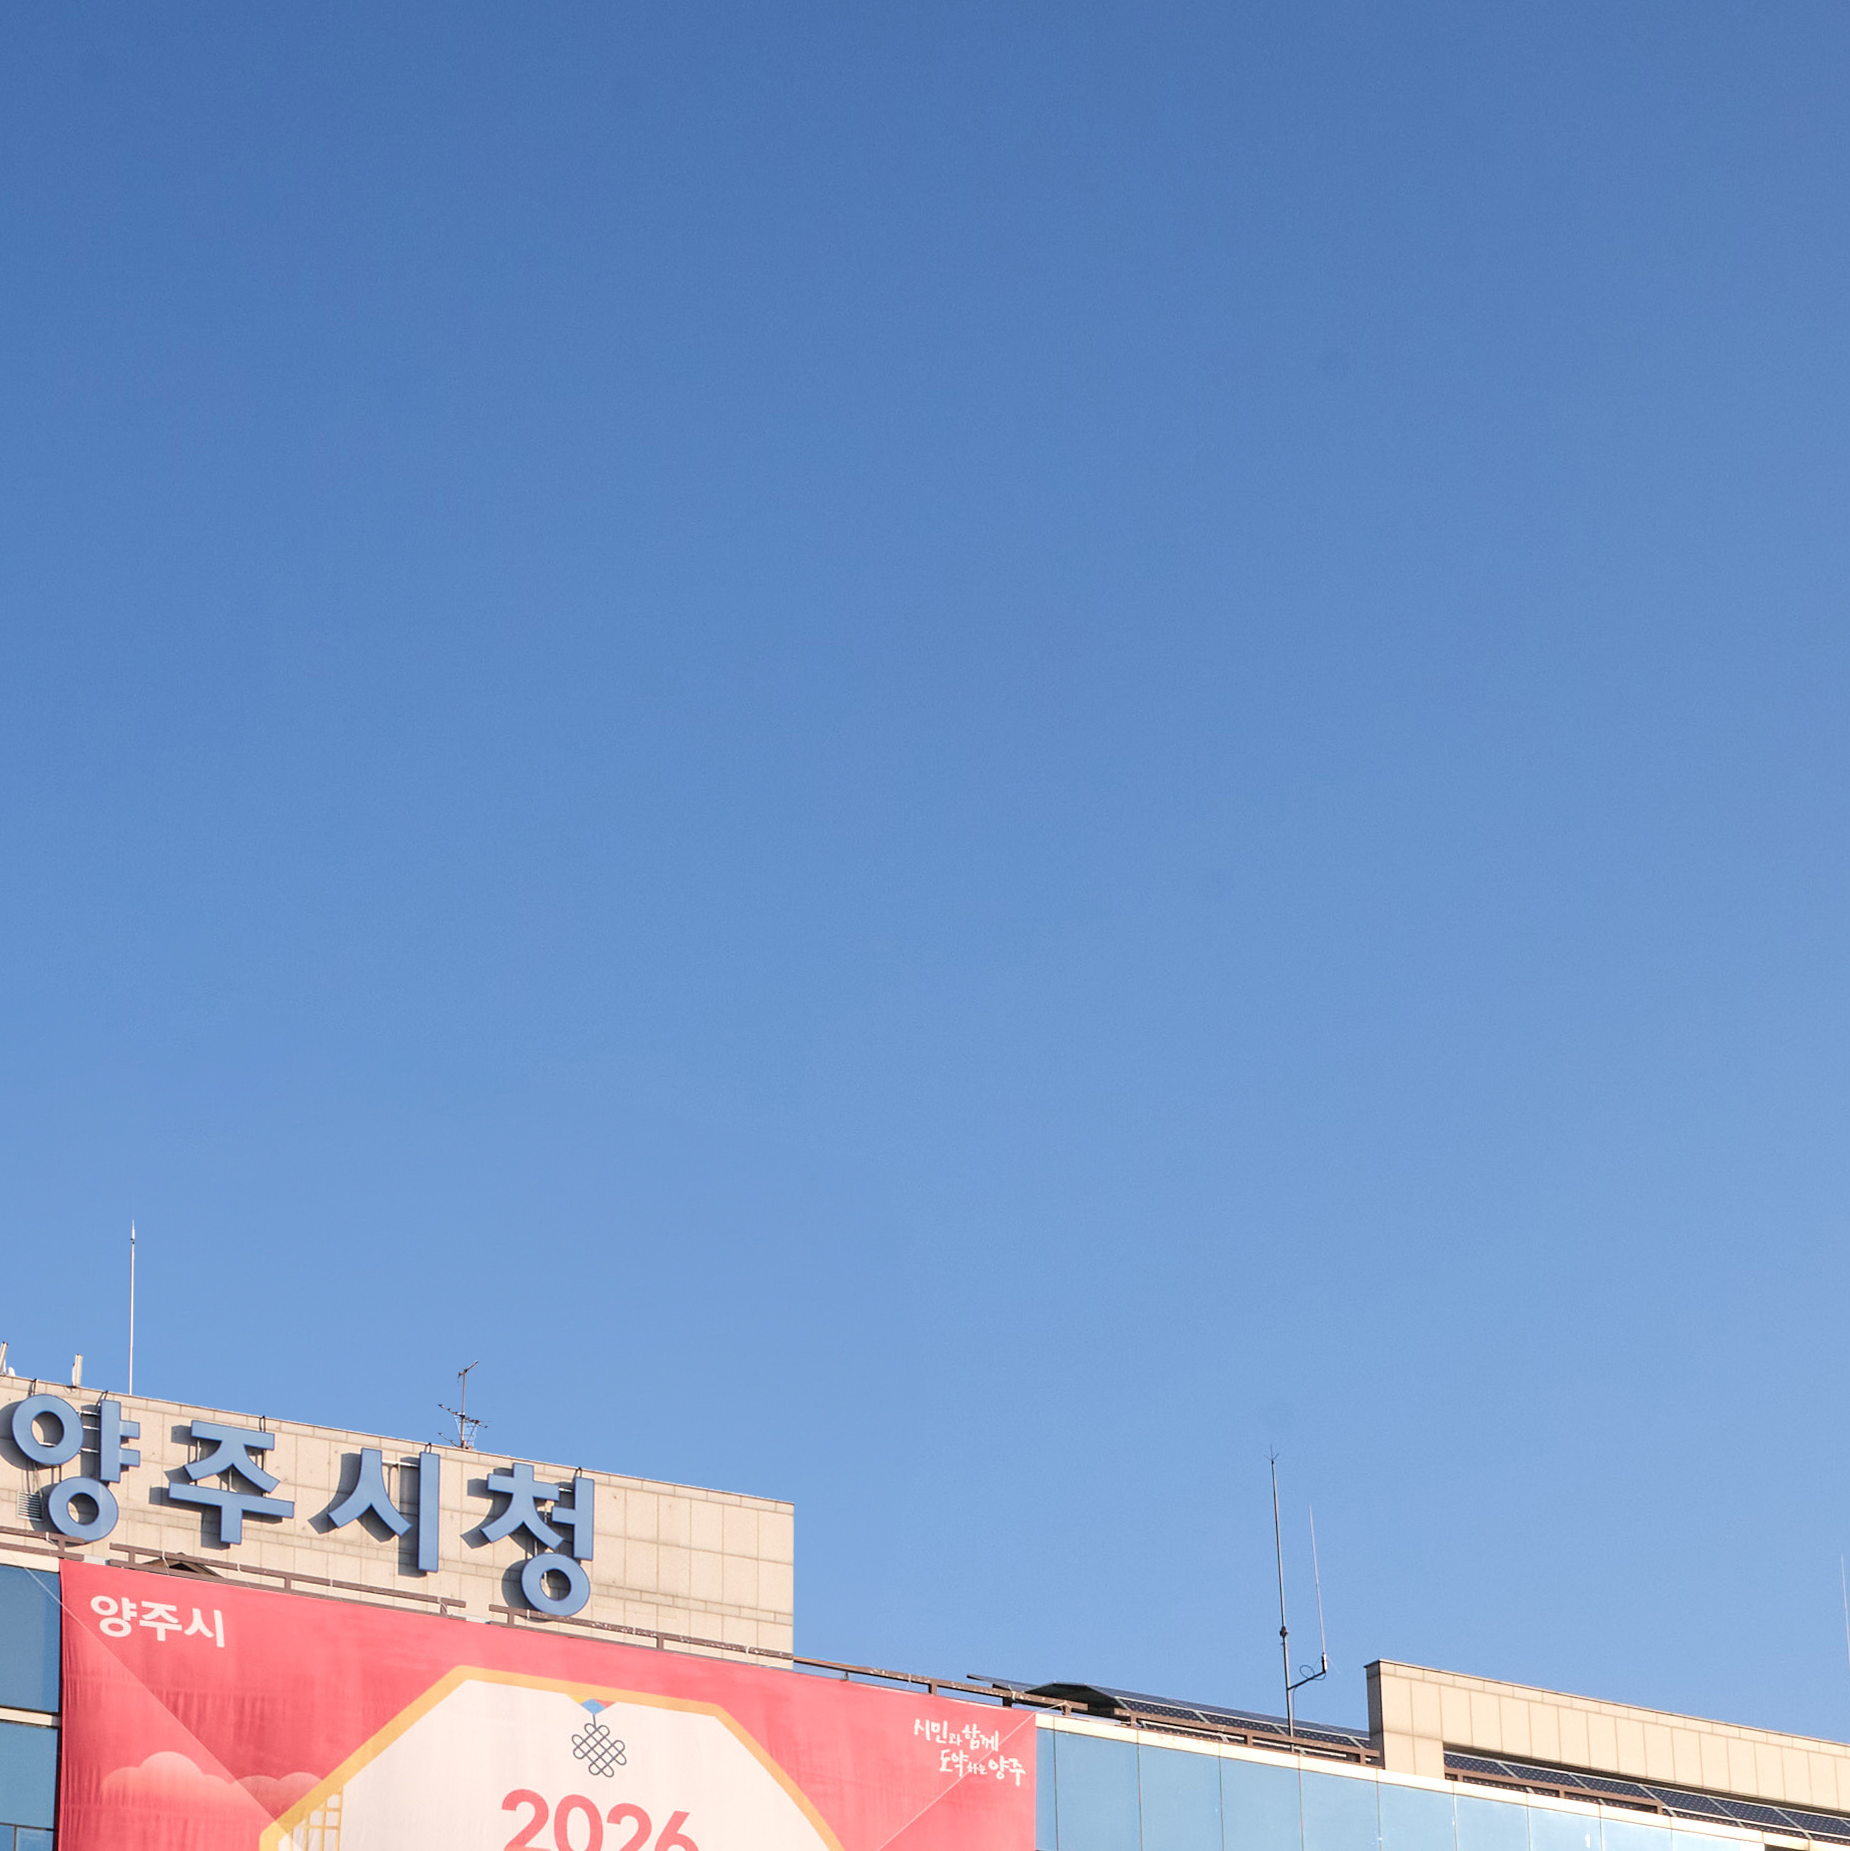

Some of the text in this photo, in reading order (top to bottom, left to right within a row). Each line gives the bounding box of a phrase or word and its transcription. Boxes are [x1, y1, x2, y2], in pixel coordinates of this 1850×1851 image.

[11, 1392, 595, 1617] 양주시청
[88, 1593, 226, 1648] 양주시
[914, 1718, 999, 1751] 시민과 함께
[939, 1749, 1027, 1787] 도약하는 양주
